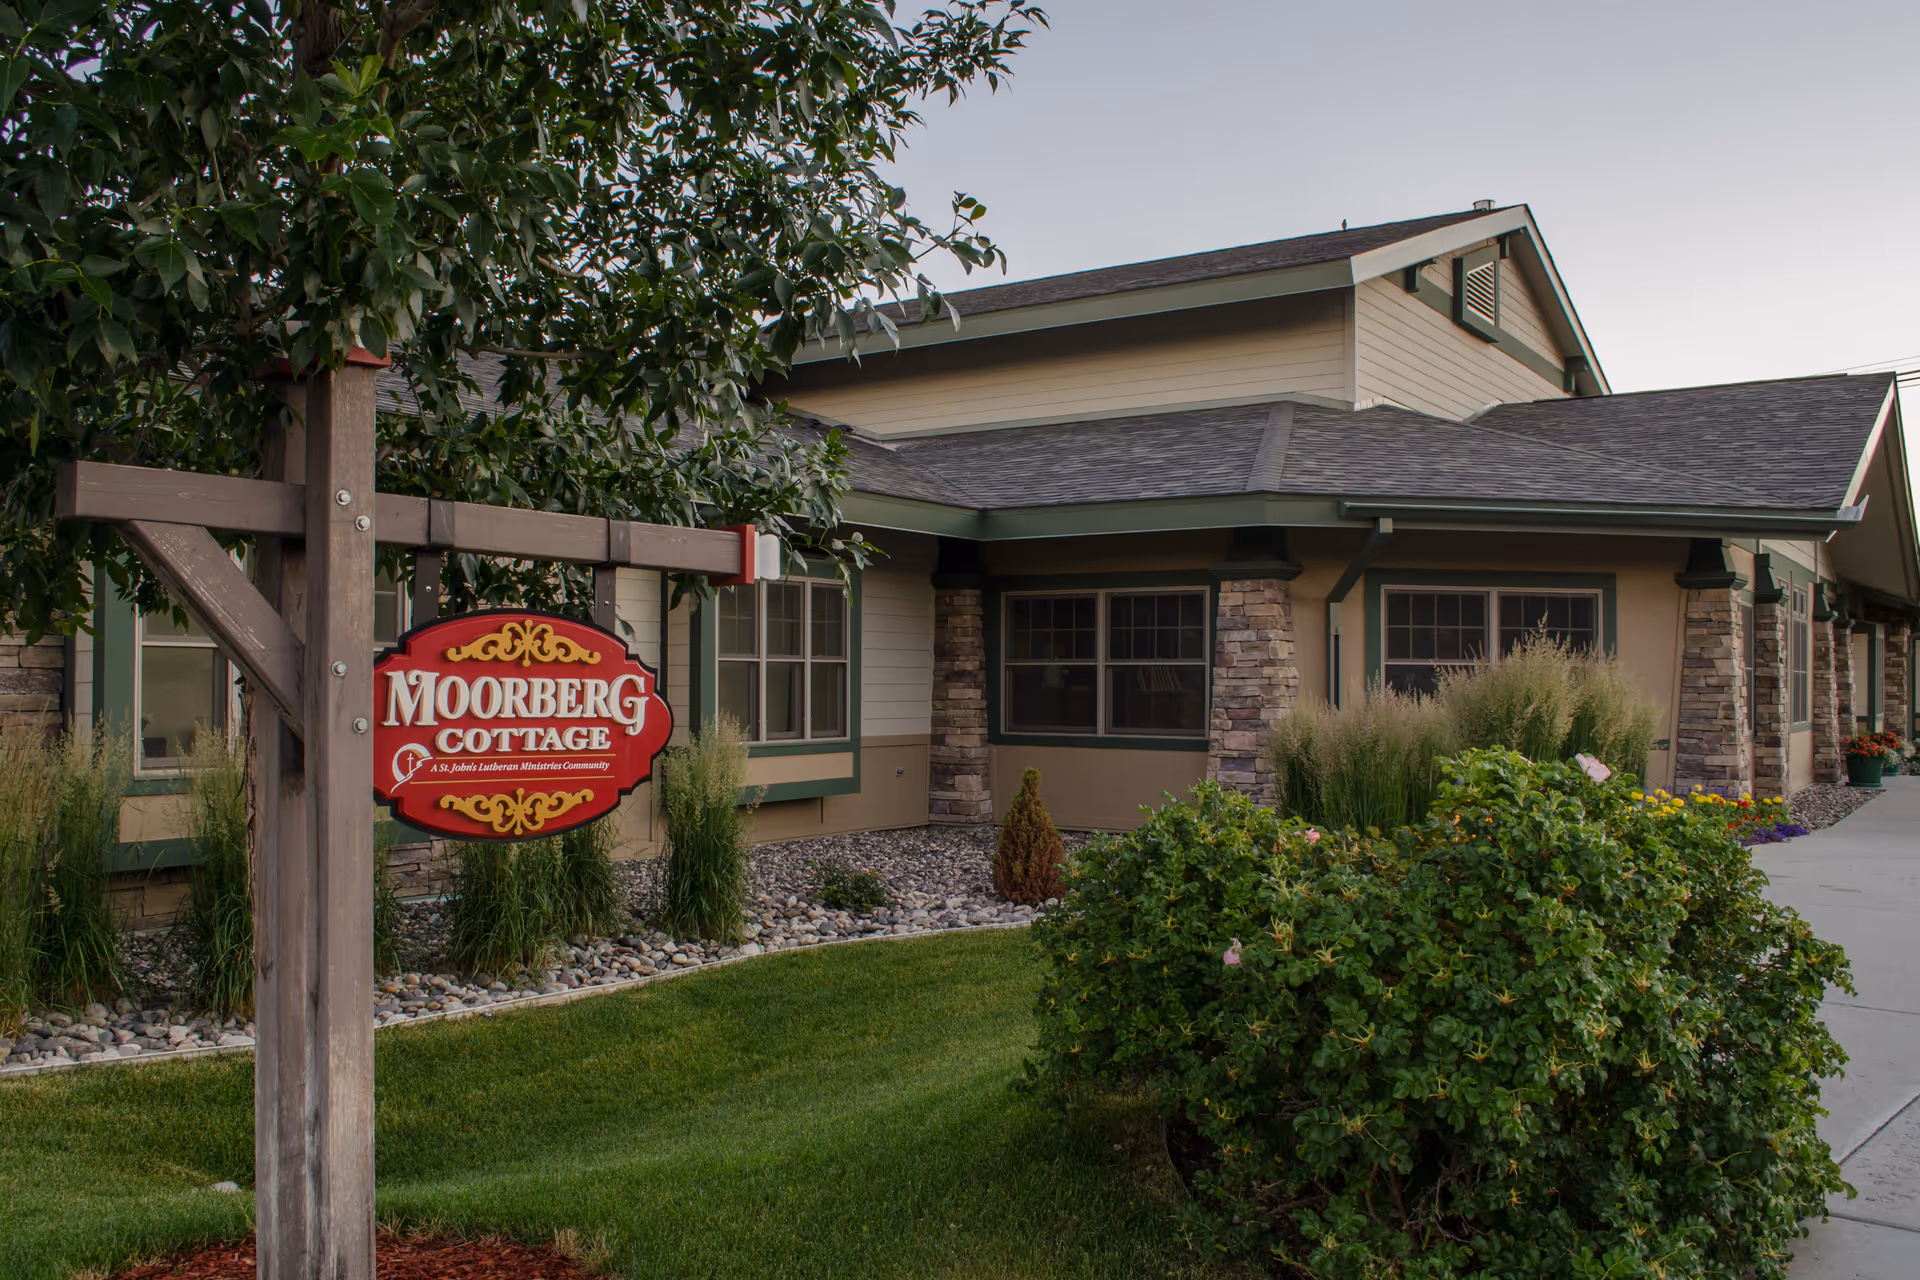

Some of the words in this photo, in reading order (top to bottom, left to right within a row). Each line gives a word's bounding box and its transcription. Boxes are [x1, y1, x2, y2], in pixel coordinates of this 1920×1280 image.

[382, 669, 649, 736] MOORBERG
[435, 727, 612, 753] COTTAGE
[430, 763, 438, 772] A
[438, 763, 449, 772] St.
[449, 762, 477, 774] John's
[478, 762, 519, 772] Lutheran
[520, 761, 562, 771] Ministries
[562, 760, 610, 771] Community
